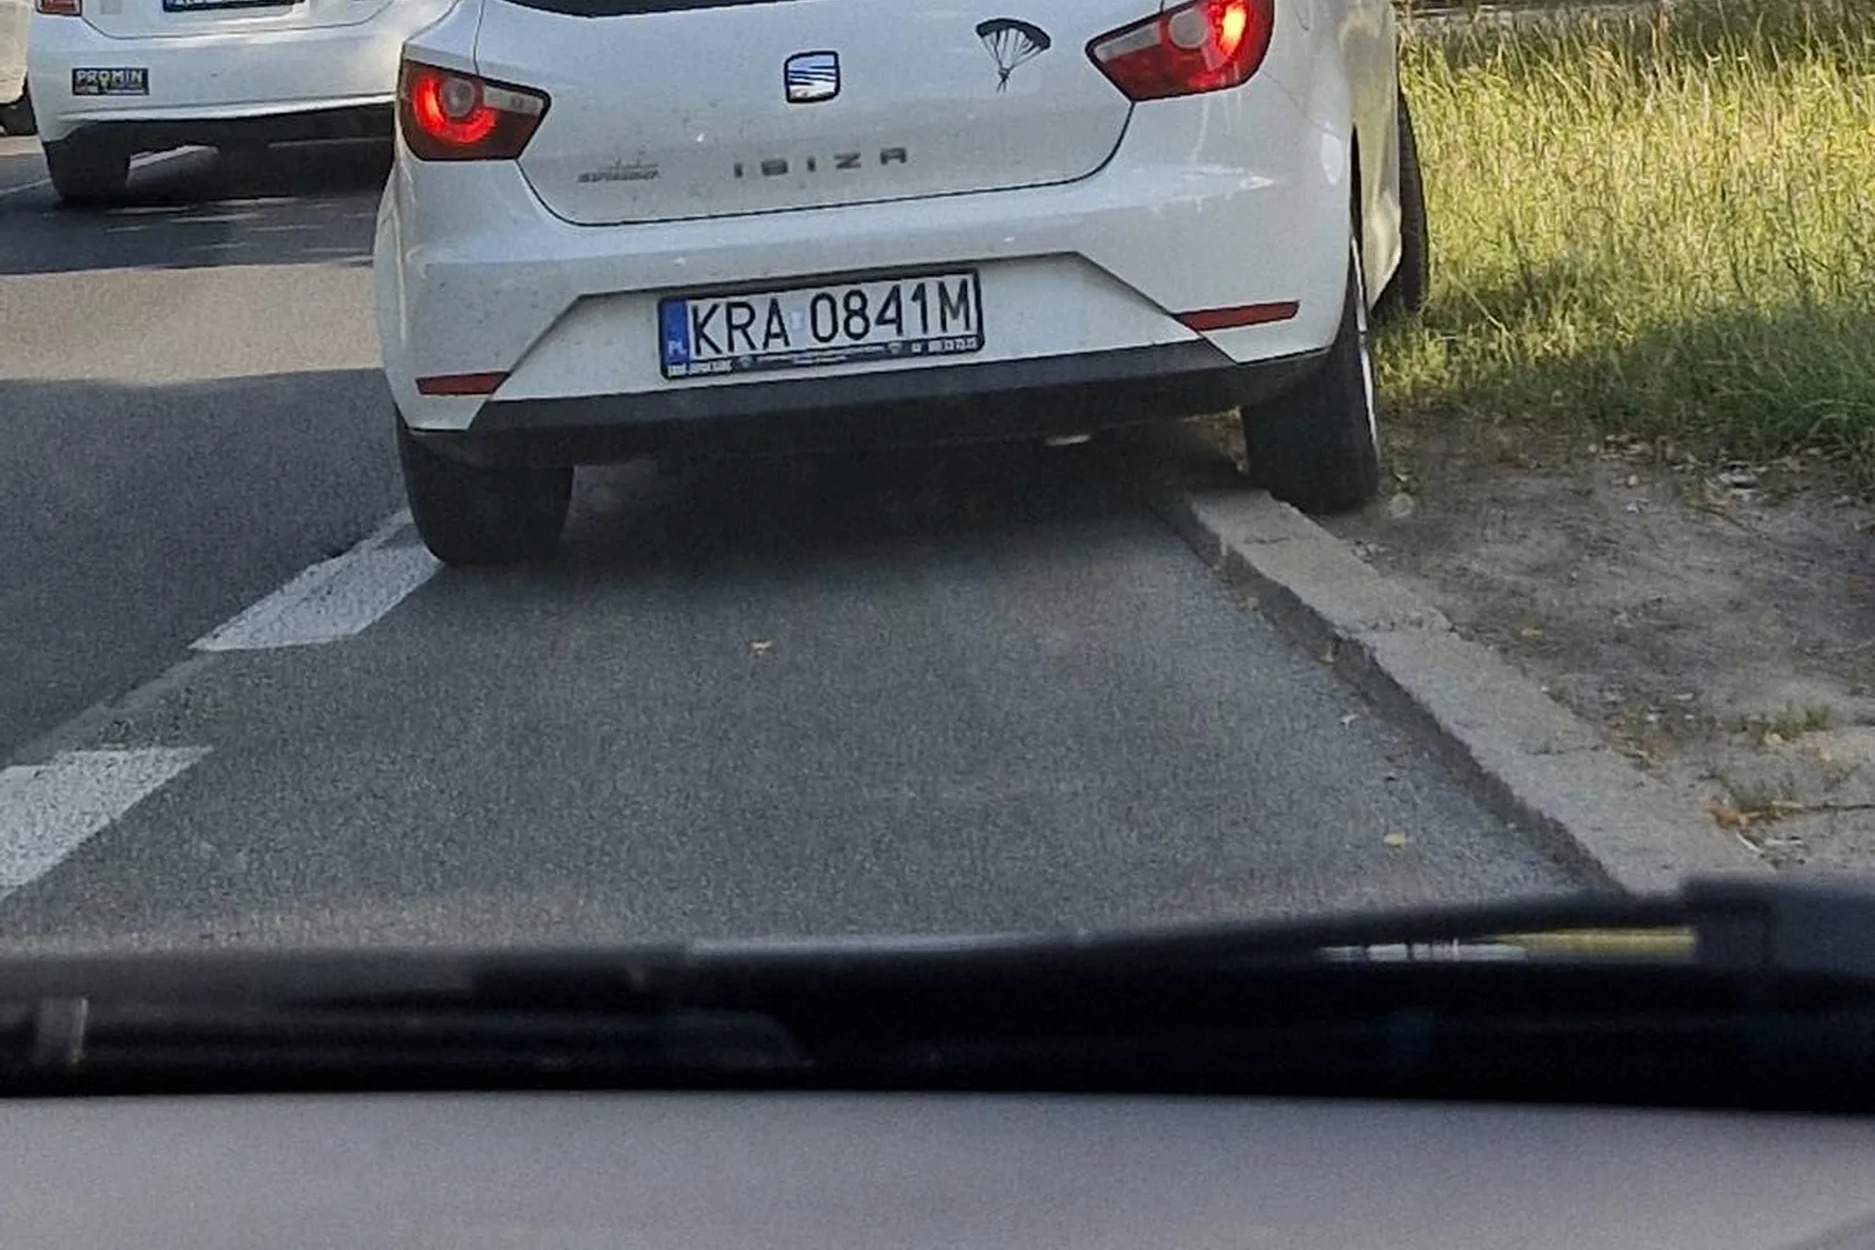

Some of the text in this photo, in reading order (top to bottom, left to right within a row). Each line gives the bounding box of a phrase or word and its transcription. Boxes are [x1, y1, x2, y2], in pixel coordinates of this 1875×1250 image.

[733, 146, 908, 179] IBIZA
[691, 277, 972, 357] KRA 0841M
